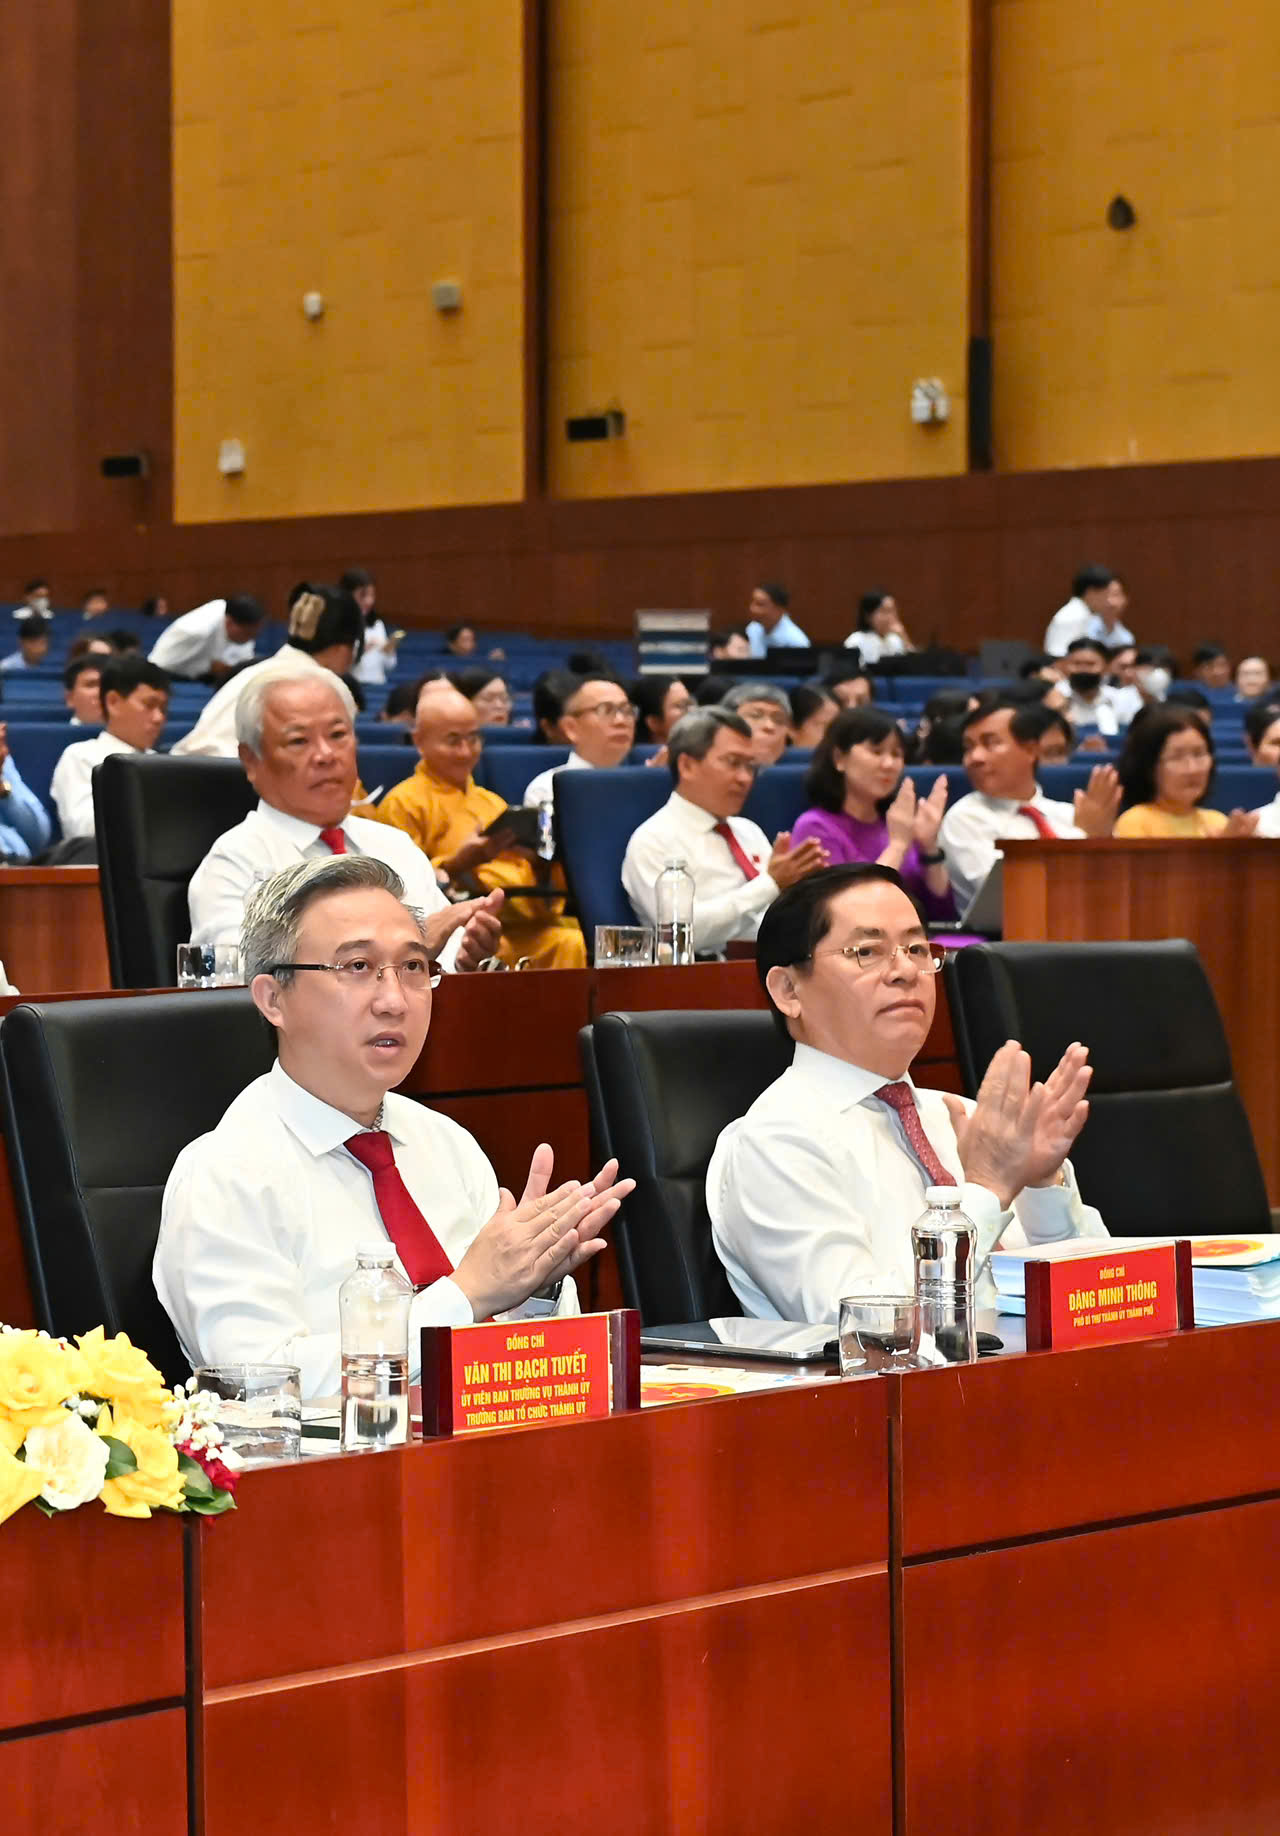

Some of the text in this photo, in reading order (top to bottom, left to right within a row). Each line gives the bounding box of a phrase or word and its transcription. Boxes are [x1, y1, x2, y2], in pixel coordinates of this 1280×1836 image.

[1069, 1279, 1157, 1314] ĐẶNG MINH THÔNG
[506, 1331, 545, 1351] ĐỒNG CHÍ
[464, 1347, 588, 1385] VĂN THỊ BẠCH TUYẾT
[473, 1389, 491, 1405] VIÊN
[492, 1390, 509, 1403] BAN
[510, 1385, 540, 1402] THƯỜNG
[542, 1385, 552, 1401] VỤ
[554, 1381, 579, 1397] THÀNH
[498, 1408, 514, 1422] BAN
[549, 1401, 575, 1417] THÀNH
